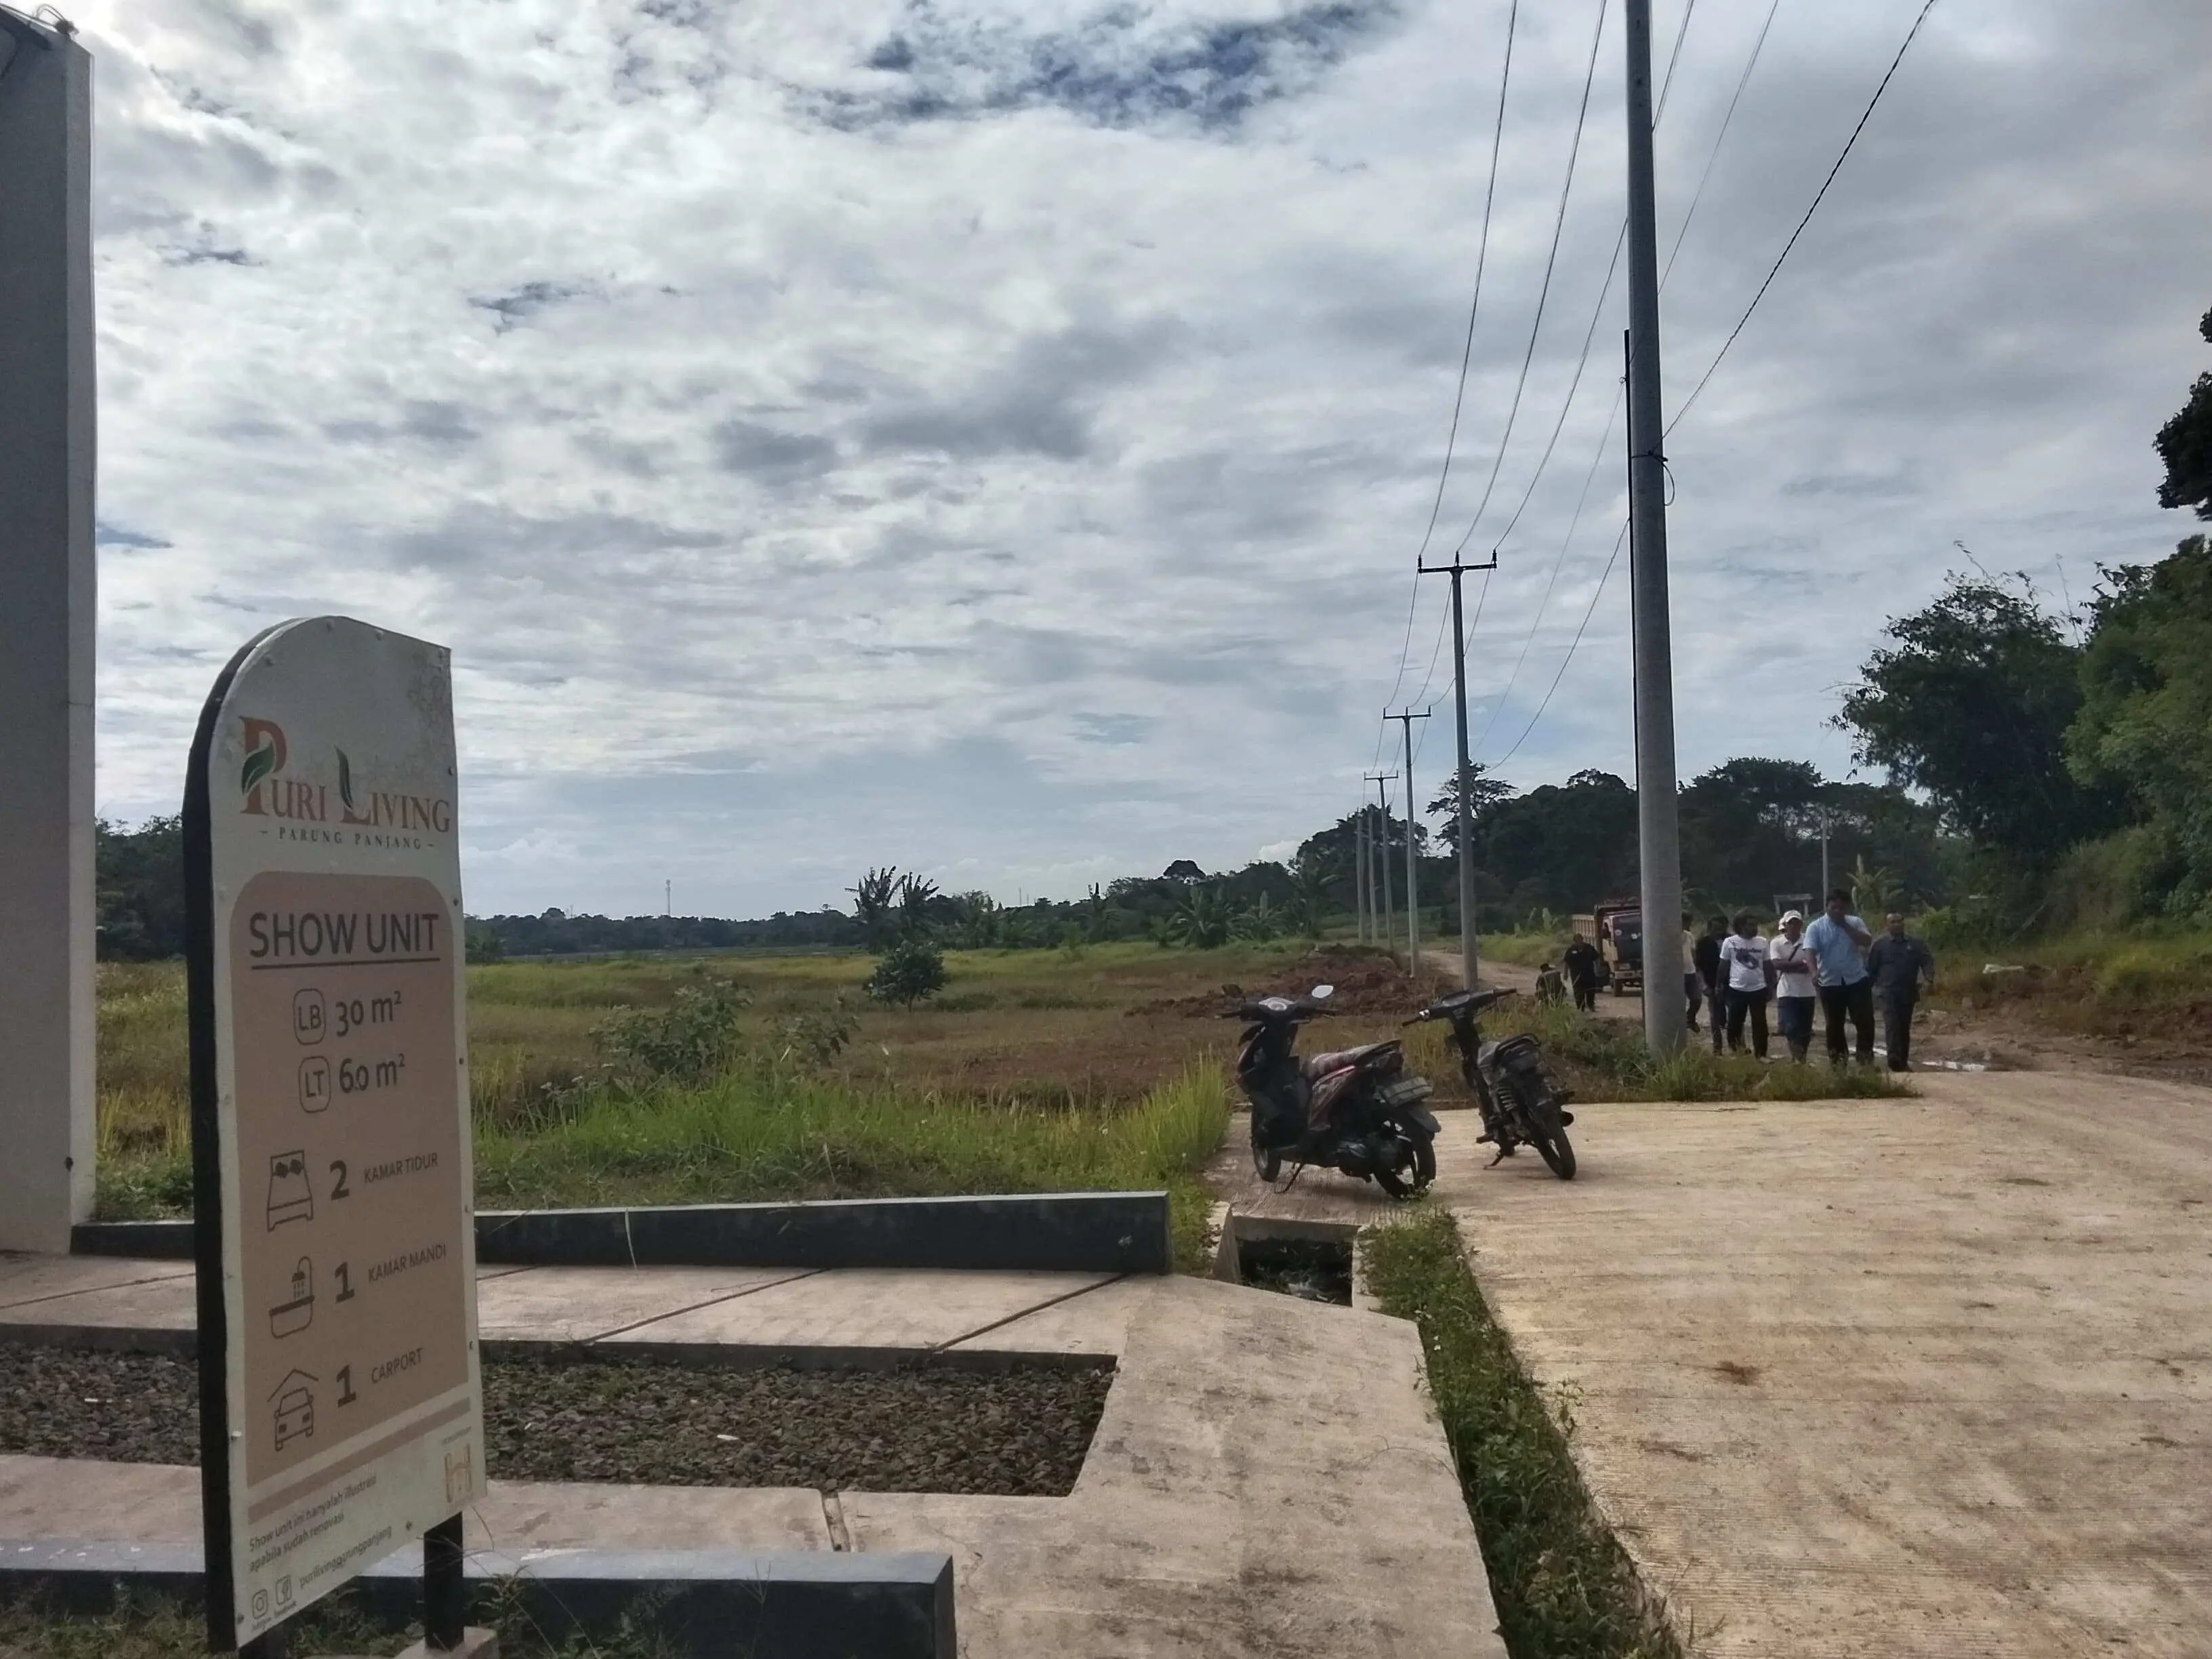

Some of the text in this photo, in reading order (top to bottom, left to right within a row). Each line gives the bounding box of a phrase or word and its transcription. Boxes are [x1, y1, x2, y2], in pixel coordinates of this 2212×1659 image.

[279, 827, 422, 850] PARUNG PANJANG
[249, 912, 439, 958] SHOW UNIT
[298, 1004, 322, 1030] LB
[335, 1000, 365, 1037] 30
[305, 1069, 325, 1098] LT
[340, 1058, 369, 1093] 60
[329, 1152, 438, 1201] 2 KAMAR TIDUR
[335, 1243, 447, 1304] 1 KAMAR MANDI
[336, 1347, 424, 1408] 1 CARPORT
[249, 1530, 273, 1553] Show
[275, 1518, 293, 1537] unit
[294, 1512, 304, 1528] ini
[306, 1491, 344, 1521] hanyalah
[250, 1511, 344, 1572] apabila sudah renovasi
